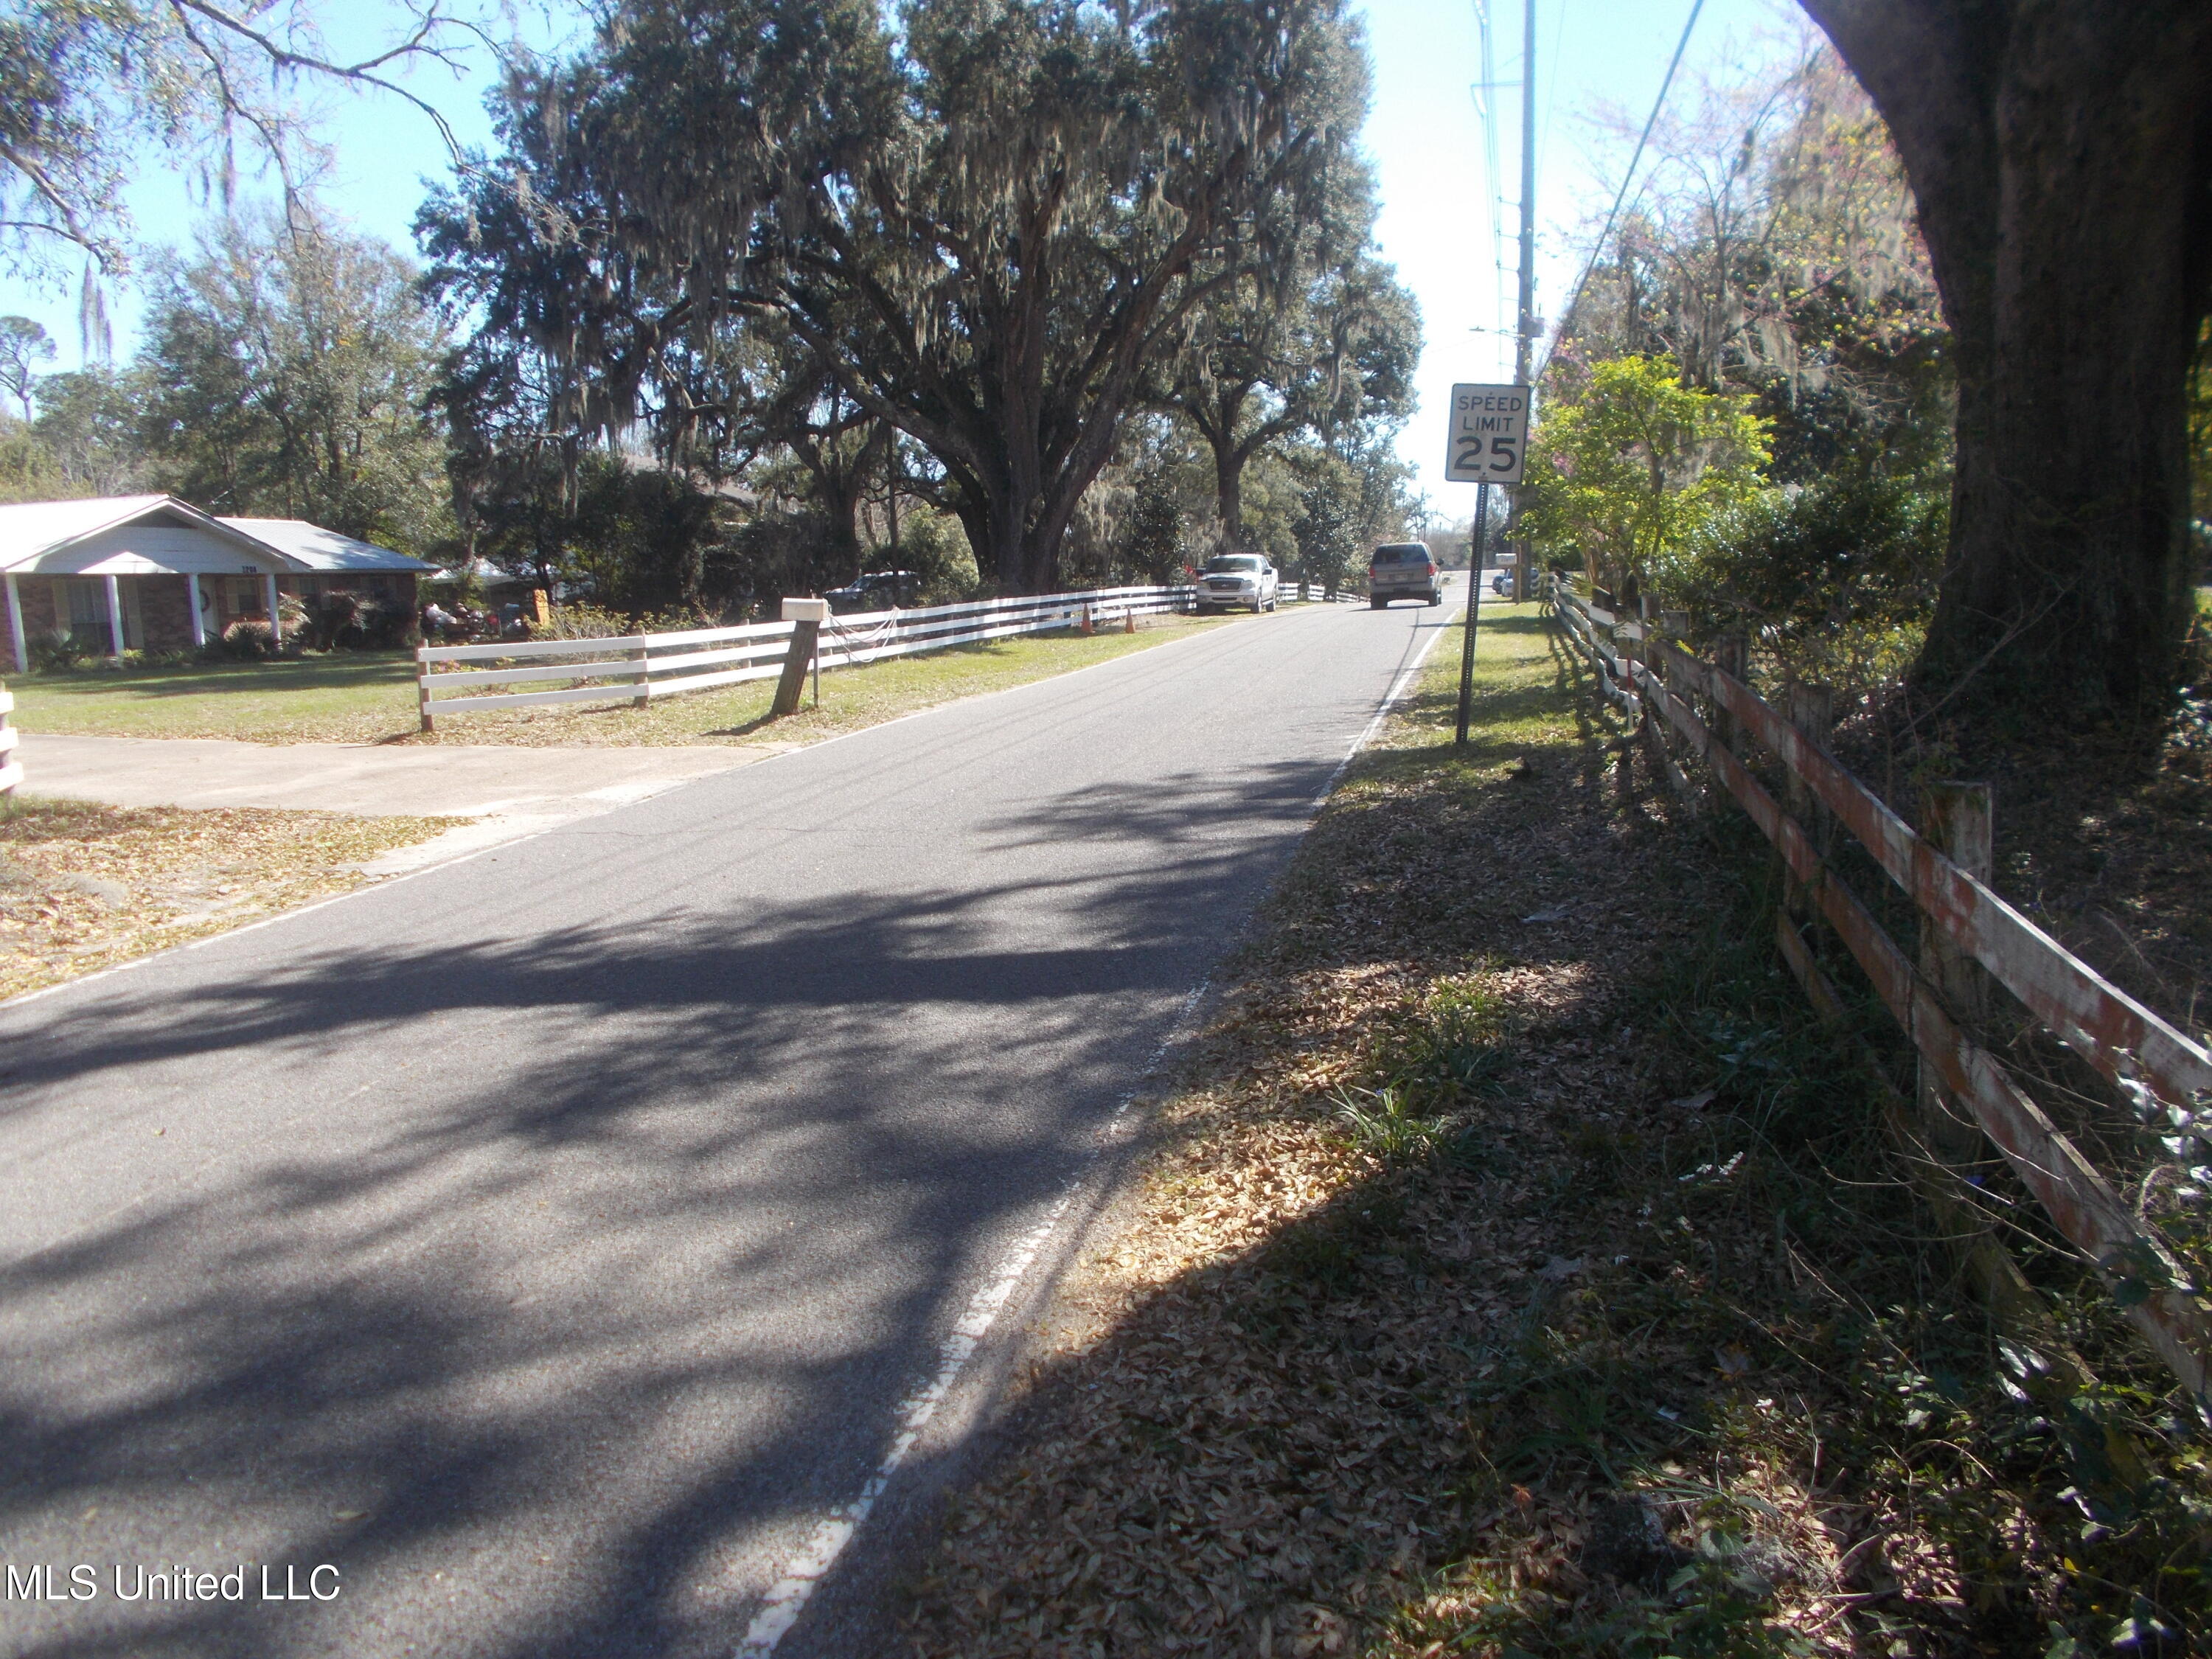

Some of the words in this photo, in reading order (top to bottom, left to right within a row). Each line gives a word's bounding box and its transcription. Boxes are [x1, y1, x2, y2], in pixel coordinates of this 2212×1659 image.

[1458, 395, 1522, 411] SPEED
[1463, 416, 1514, 431] LIMIT
[1454, 436, 1517, 472] 25
